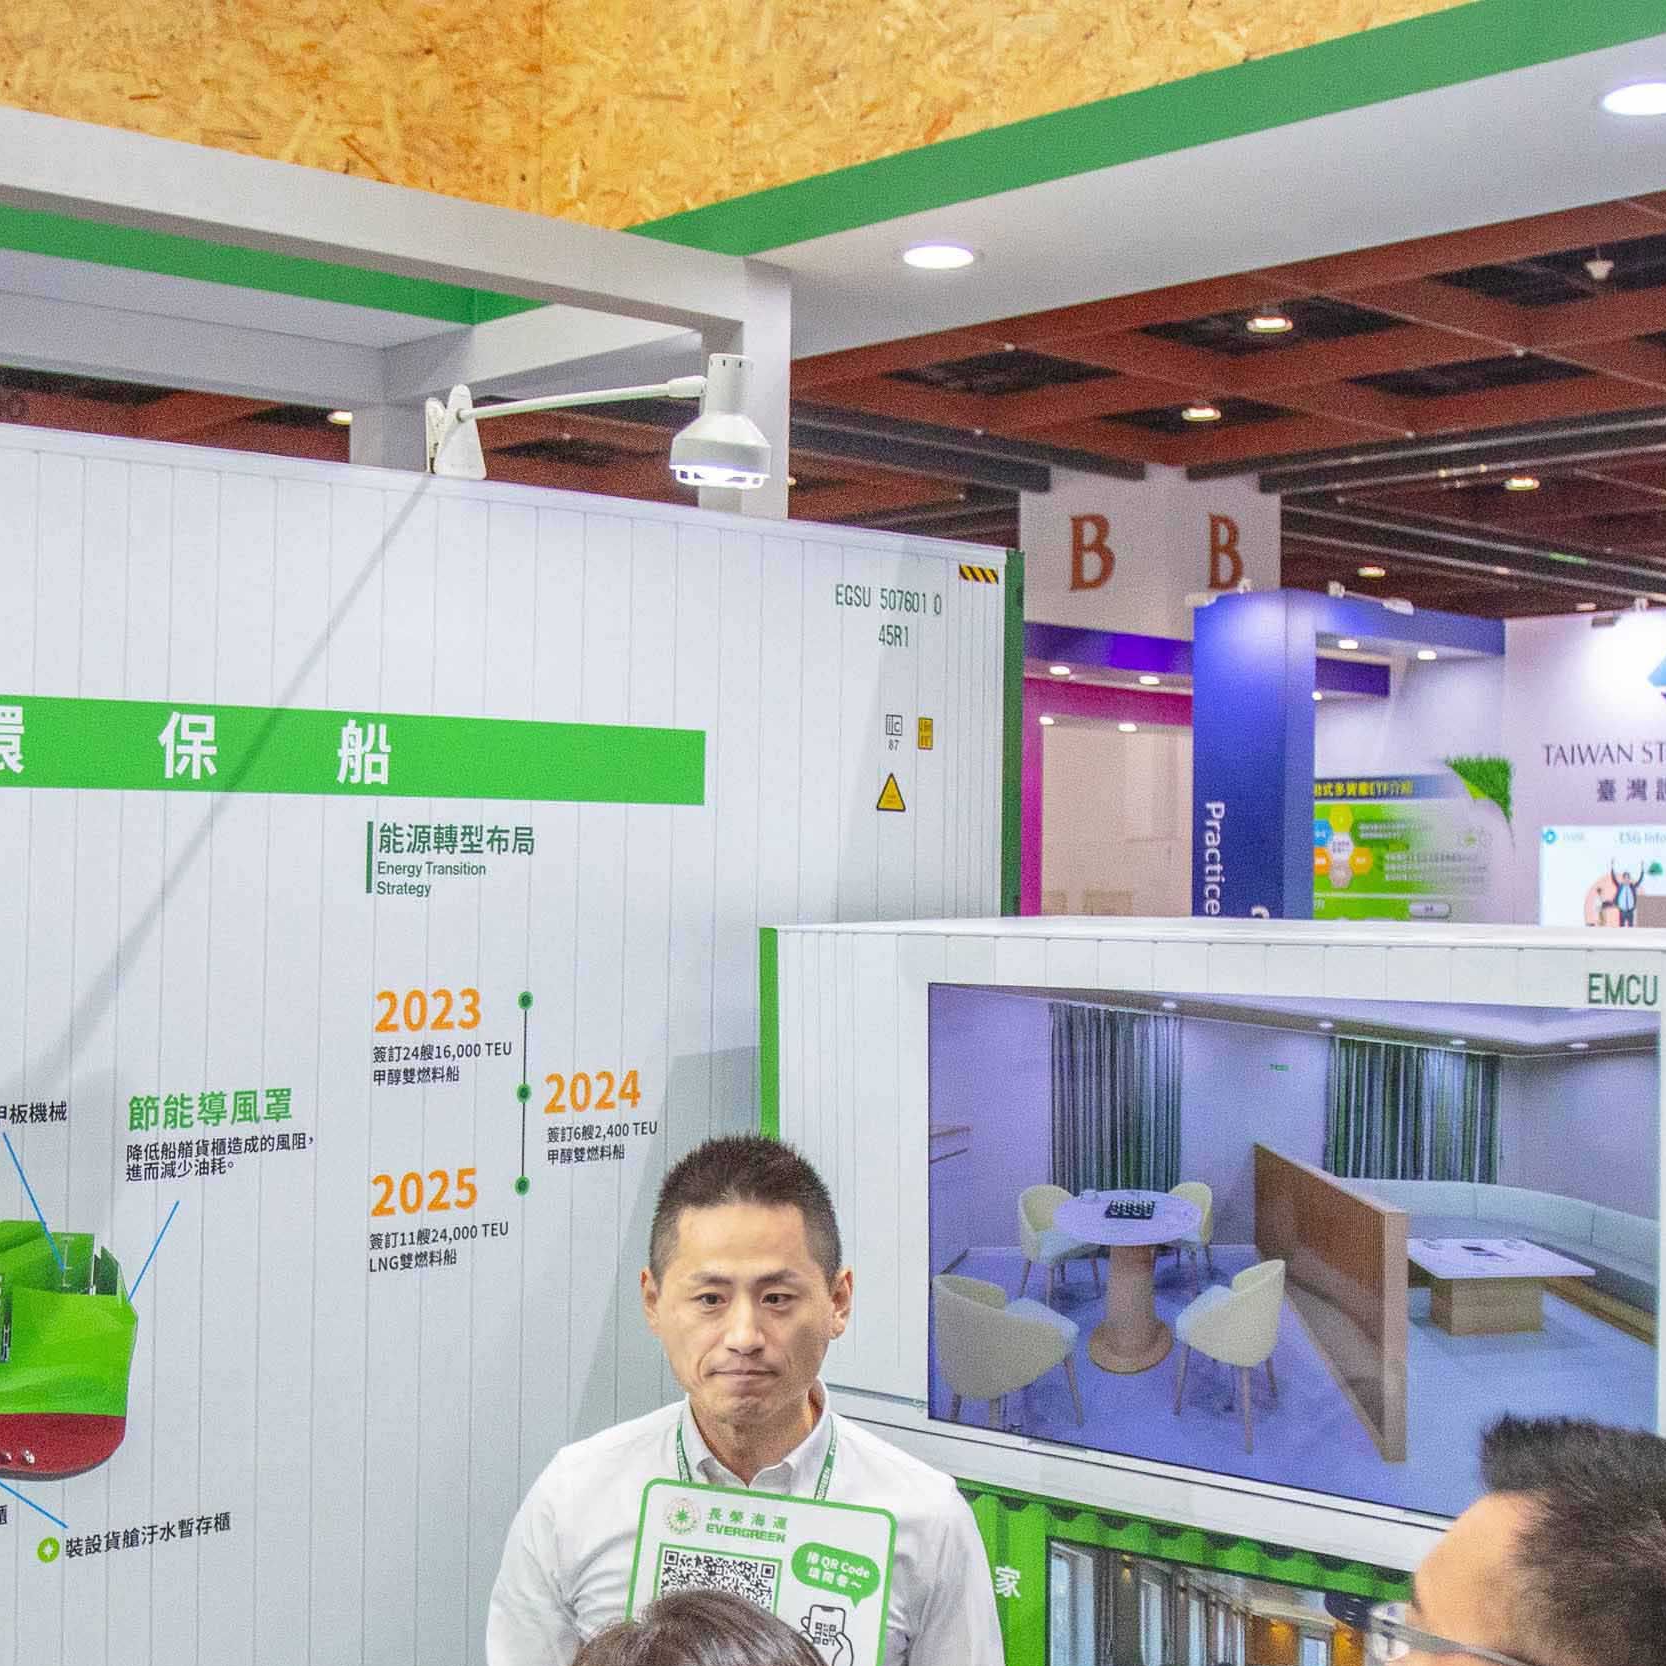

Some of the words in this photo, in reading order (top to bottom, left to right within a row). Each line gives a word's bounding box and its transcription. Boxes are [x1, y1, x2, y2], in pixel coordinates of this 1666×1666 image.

[1070, 513, 1116, 591] B
[1208, 512, 1244, 590] B
[835, 584, 871, 608] EGSU
[933, 595, 942, 615] 0
[878, 625, 909, 647] 45R1
[1544, 743, 1634, 767] TAIWAN
[378, 823, 535, 857] 能源轉型布局
[377, 860, 421, 878] Energy
[425, 861, 486, 877] Transition
[1204, 800, 1226, 918] Practice
[376, 880, 432, 898] Strategy
[1586, 973, 1659, 1006] EMCU
[374, 988, 482, 1033] 2023
[485, 1041, 513, 1057] TEU
[373, 1064, 460, 1088] 甲醇雙燃料船
[544, 1069, 642, 1114] 2024
[128, 1087, 293, 1132] 節能導風罩
[633, 1120, 659, 1137] TEU
[370, 1167, 479, 1217] 2025
[482, 1220, 509, 1237] TEU
[369, 1248, 458, 1273] LNG雙燃料船
[708, 1506, 789, 1531] 長榮海運
[705, 1523, 787, 1544] EVERGREEN
[840, 1558, 871, 1579] Code
